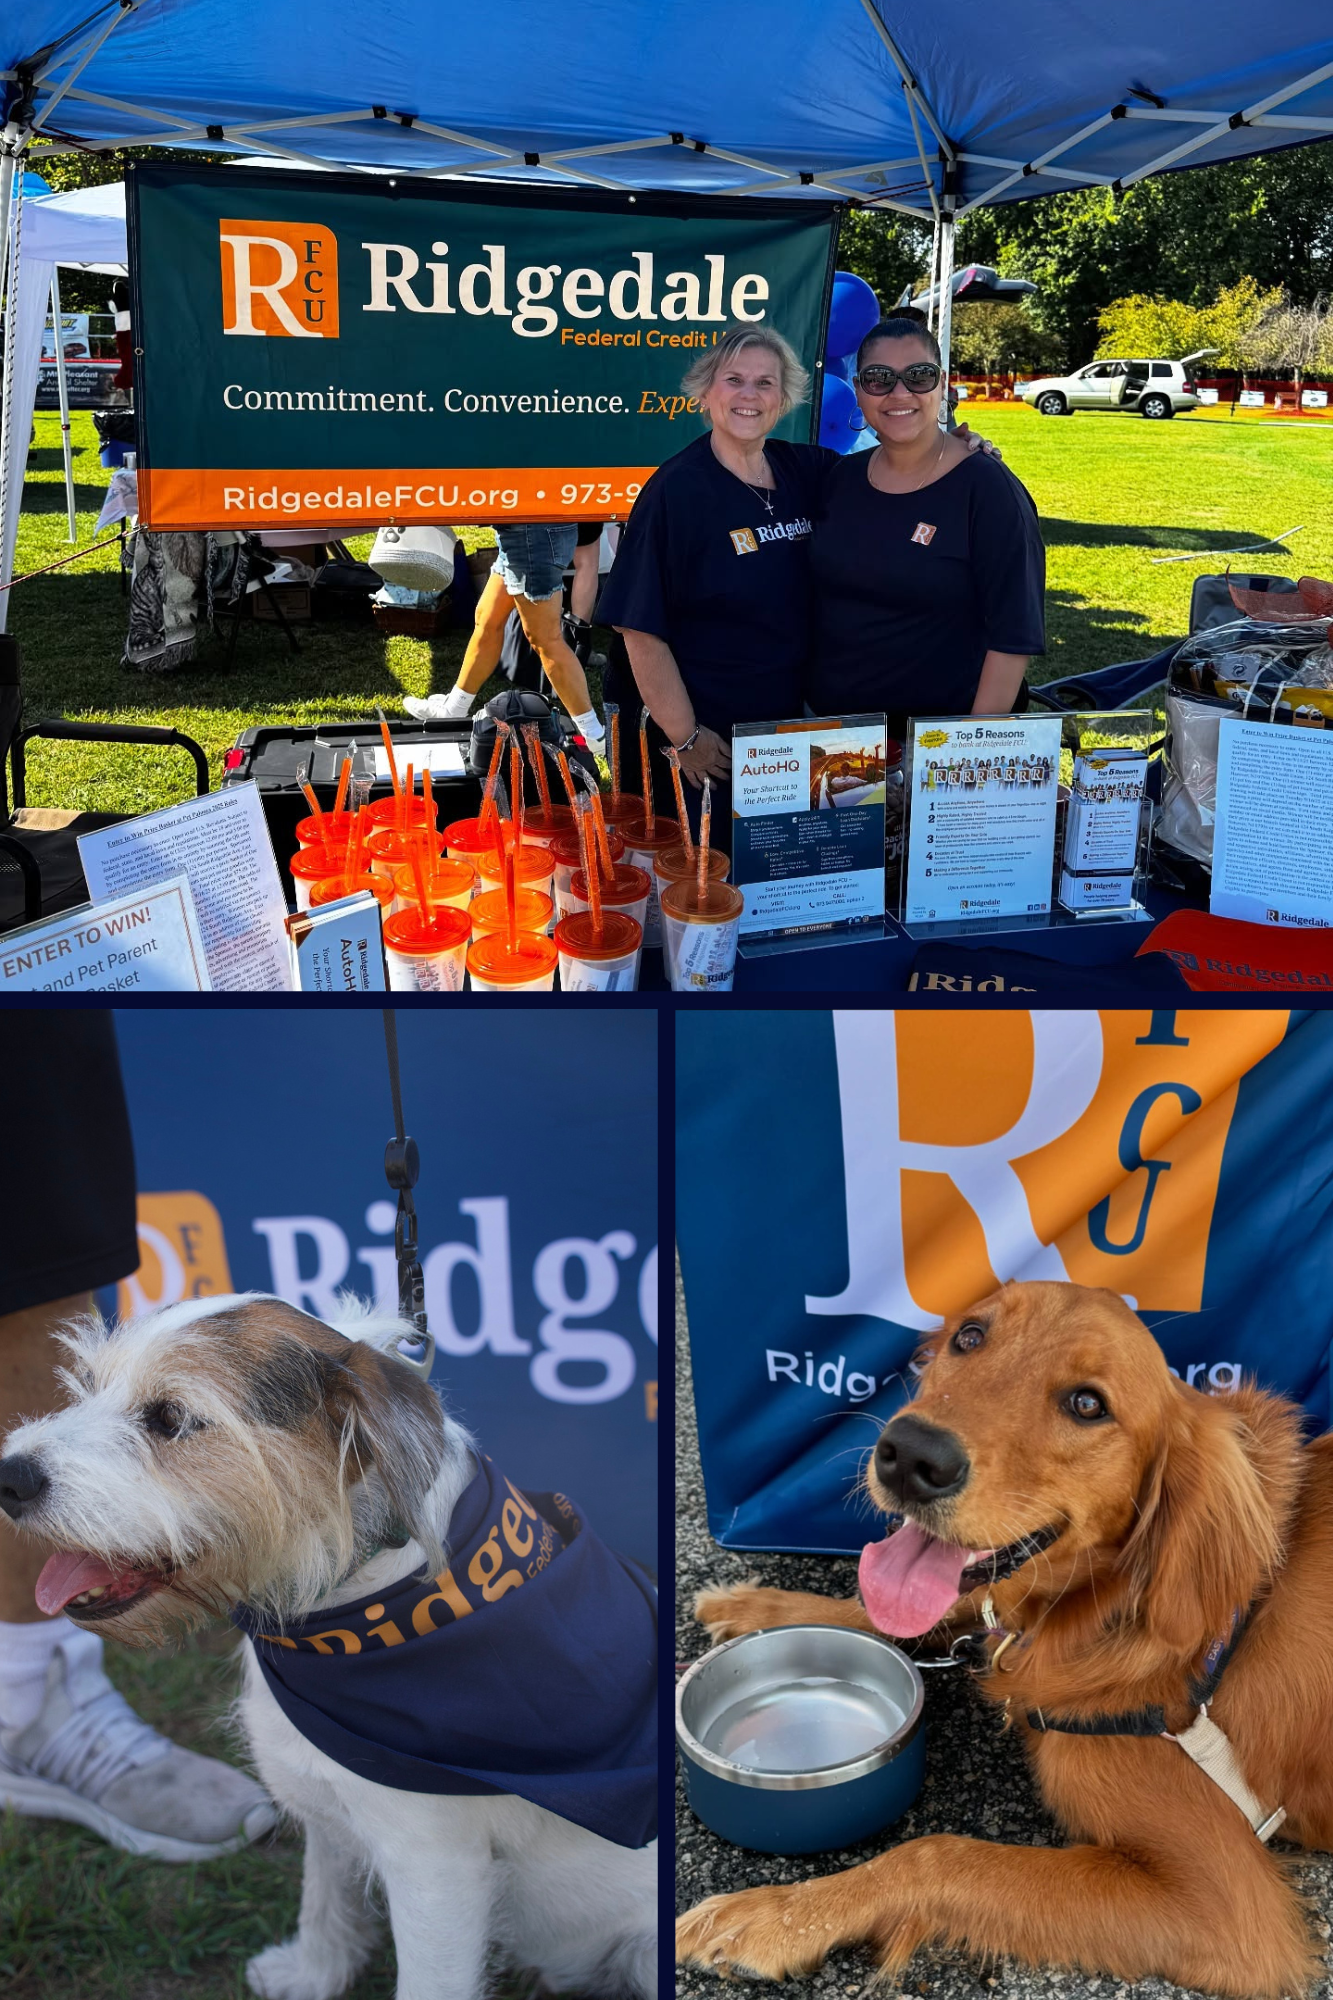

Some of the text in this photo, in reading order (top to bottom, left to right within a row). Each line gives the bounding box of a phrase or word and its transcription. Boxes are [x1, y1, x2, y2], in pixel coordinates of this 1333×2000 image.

[362, 241, 769, 338] Ridgedale
[561, 328, 641, 347] Federal
[645, 331, 707, 348] Credit
[223, 385, 434, 413] Commitment.
[444, 386, 629, 414] Convenience.
[223, 484, 519, 512] RidgedaleFCU.org
[956, 728, 1024, 741] Top 5 Reasons
[758, 746, 794, 758] Ridgedale
[740, 760, 800, 776] AutoHQ
[744, 786, 760, 795] Your
[756, 794, 780, 804] Perfect
[782, 793, 796, 802] Ride
[929, 802, 934, 810] 1
[928, 814, 935, 823] 2
[927, 834, 934, 843] 3
[926, 852, 933, 860] 4
[926, 868, 932, 877] 5
[970, 899, 1000, 907] Ridgedale
[1281, 913, 1330, 928] Ridgedale
[3, 906, 152, 978] ENTER TO WIN!
[78, 960, 106, 981] Pet
[107, 938, 159, 969] Parent
[340, 939, 357, 991] AutoH
[360, 951, 370, 990] Ridgedale
[922, 972, 1037, 991] Rid
[252, 1197, 658, 1405] Ridg
